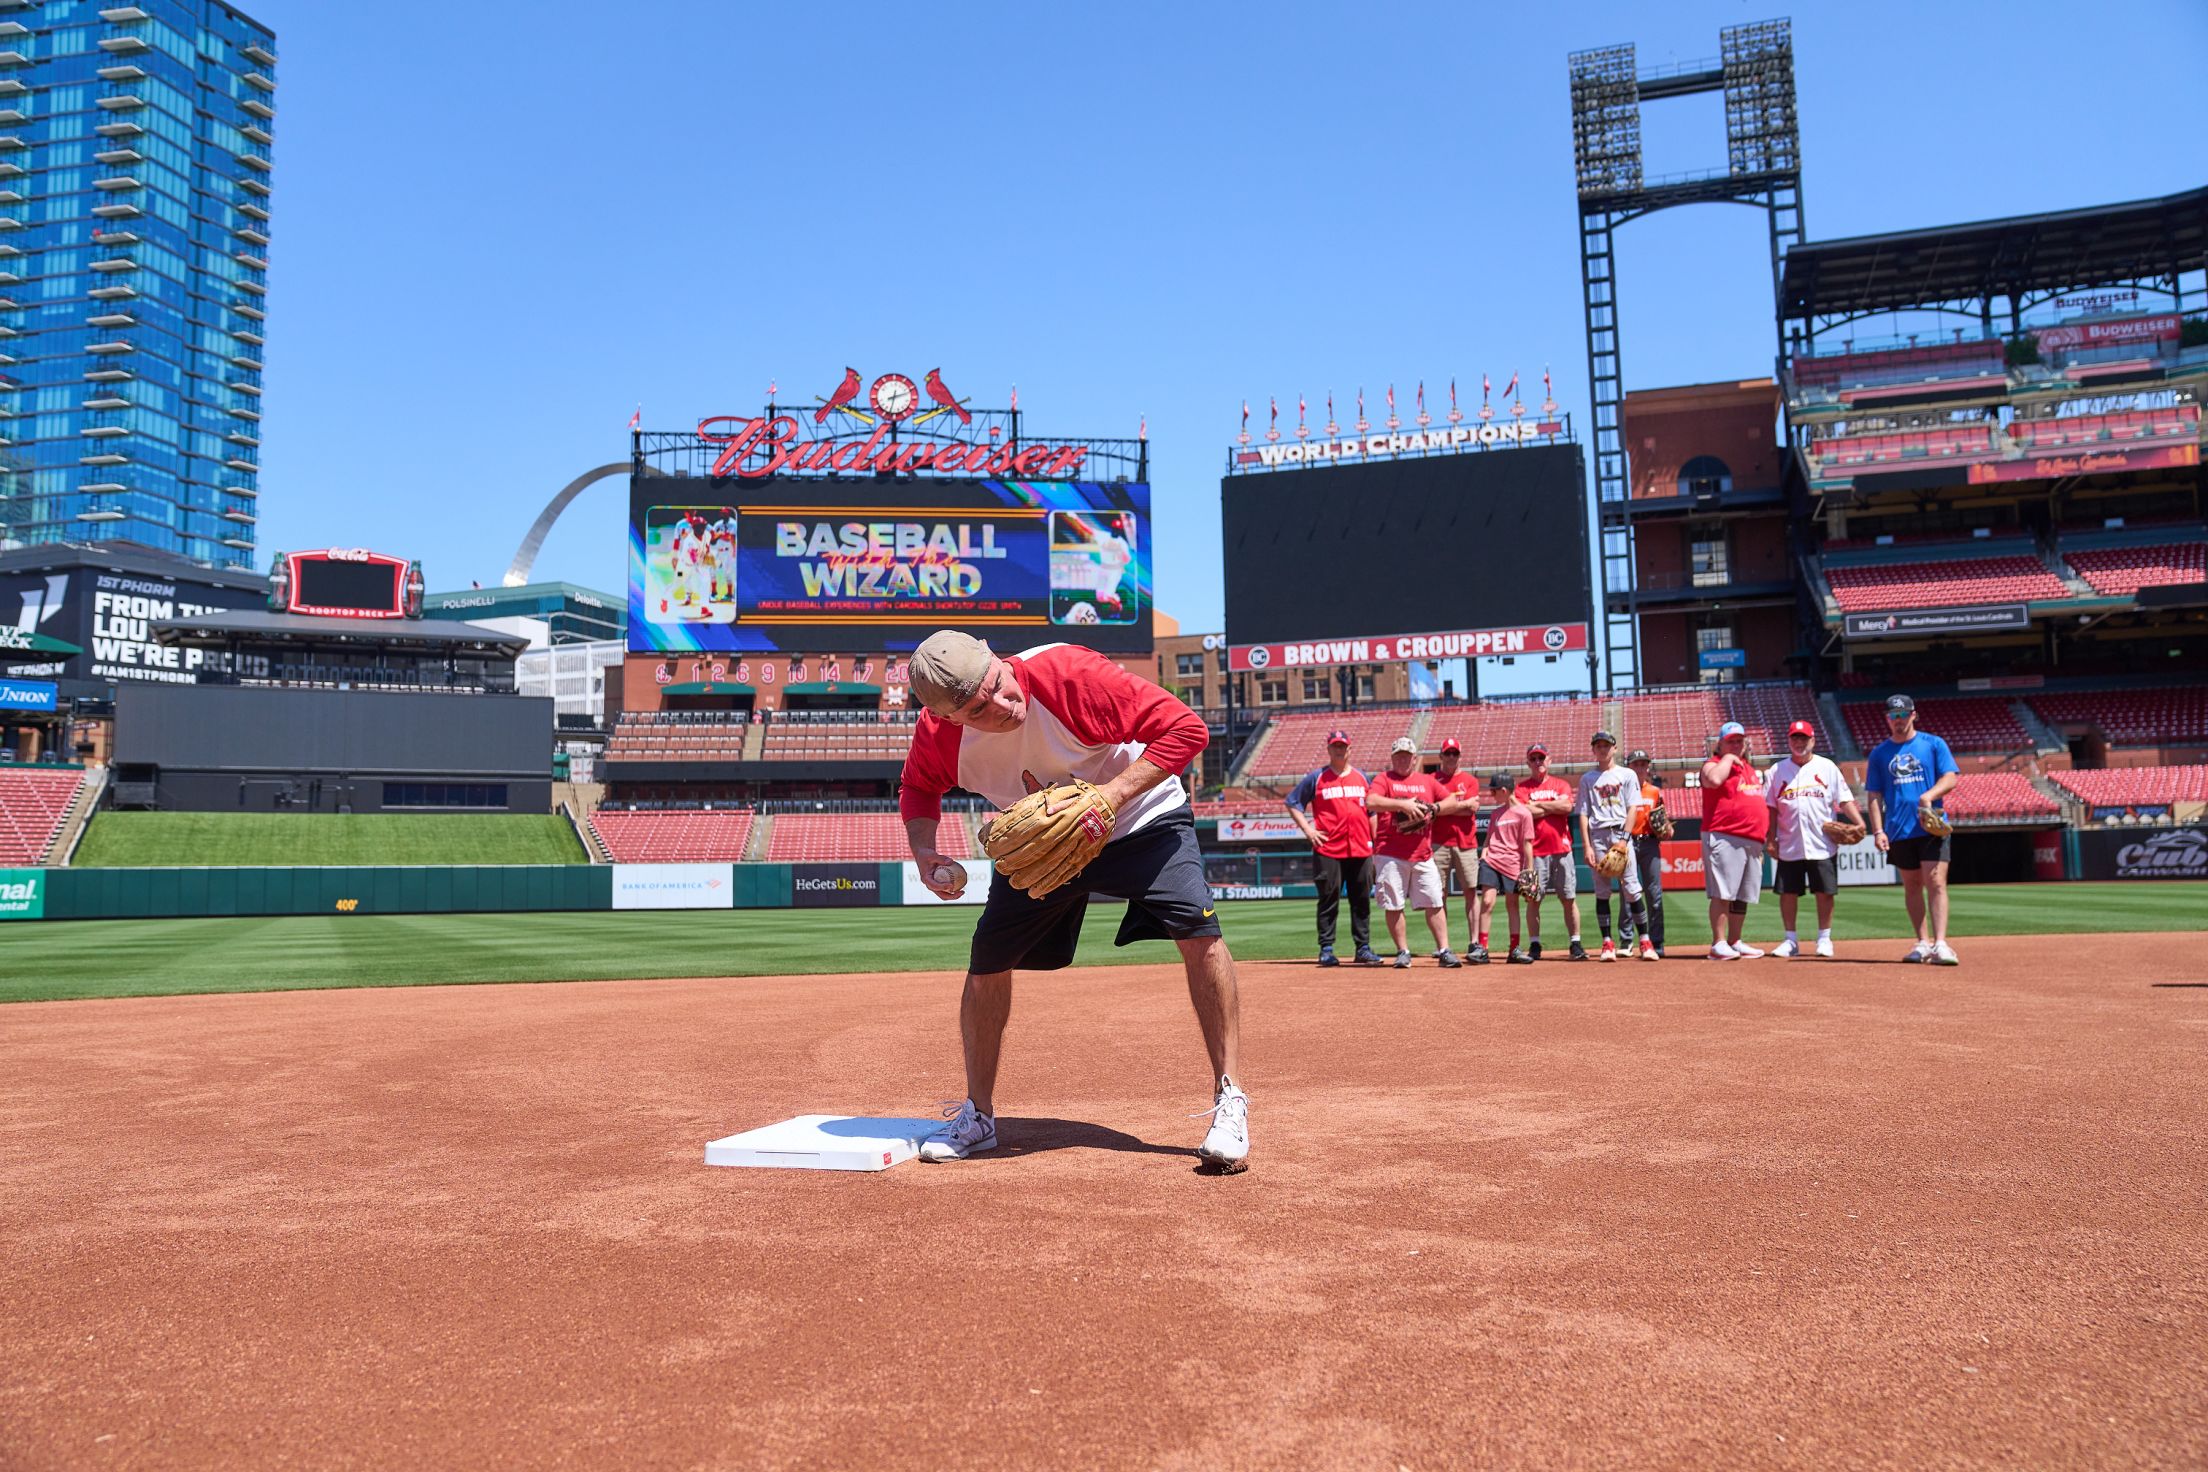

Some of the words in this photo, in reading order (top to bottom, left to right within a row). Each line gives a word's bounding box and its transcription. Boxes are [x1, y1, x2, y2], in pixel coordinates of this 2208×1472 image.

[2089, 319, 2176, 337] BUDWEISER
[697, 416, 1089, 478] Budweiser
[1257, 440, 1360, 465] WORLD
[1366, 422, 1538, 454] CHAMPIONS
[776, 522, 1007, 558] BASEBALL
[97, 576, 120, 588] 1ST
[121, 577, 176, 597] PHORM
[799, 562, 983, 597] WIZARD
[94, 592, 173, 621] FROM
[309, 607, 355, 616] ROOFTOP
[358, 610, 384, 618] DECK
[443, 597, 495, 609] POLSINELLI
[786, 600, 821, 609] BASEBALL
[895, 601, 932, 610] CARDINALS
[93, 614, 147, 642] LOU
[1859, 620, 1888, 631] Mercy
[91, 637, 179, 667] WE'RE
[1284, 641, 1369, 666] BROWN
[1375, 643, 1390, 659] &
[1396, 630, 1528, 659] CROUPPEN
[91, 665, 196, 684] #IAM1STPHORM
[711, 663, 725, 682] 2
[736, 663, 750, 683] 6
[761, 663, 775, 684] 9
[787, 663, 807, 684] 10
[820, 662, 841, 682] 14
[853, 662, 874, 683] 17
[1249, 820, 1313, 832] Schnuc
[1674, 857, 1704, 873] Stat
[2116, 842, 2208, 868] Club
[795, 878, 877, 891] HeGetsUs.com
[1227, 886, 1283, 899] STADIUM
